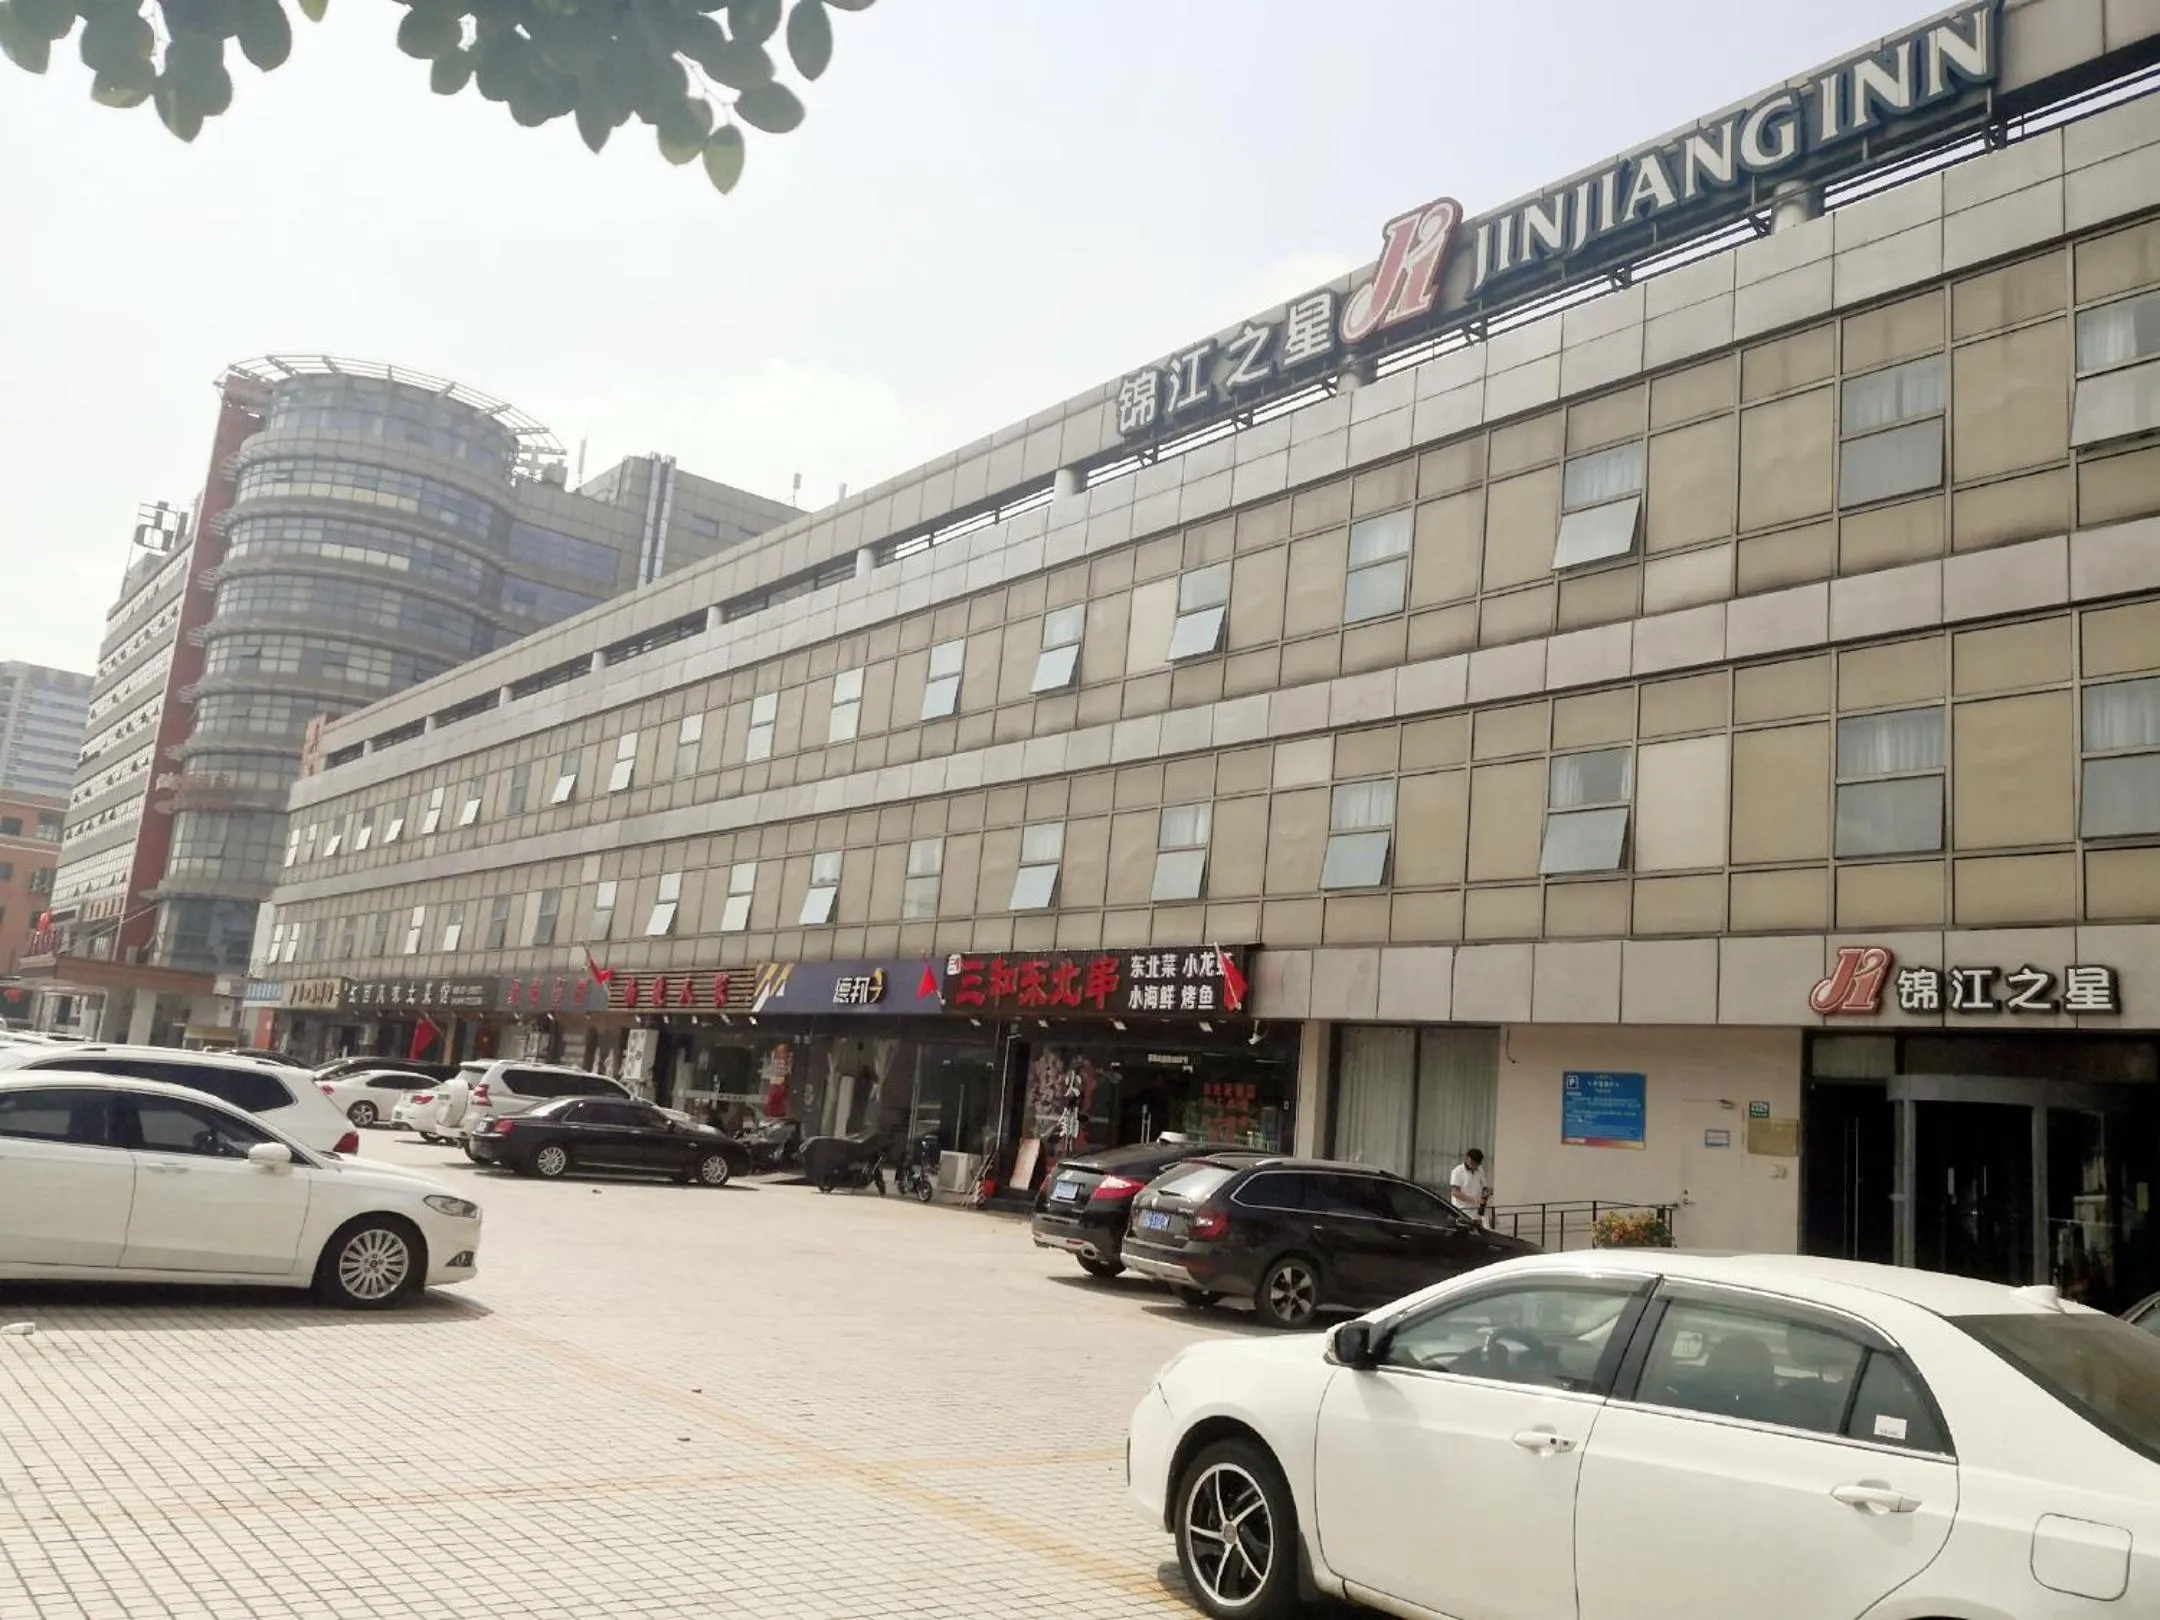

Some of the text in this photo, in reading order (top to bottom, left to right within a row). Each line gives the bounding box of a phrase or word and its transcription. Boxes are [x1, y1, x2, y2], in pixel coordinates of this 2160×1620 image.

[1473, 9, 1990, 291] JINJIANG INN
[1119, 292, 1334, 427] 锦江之星
[1130, 953, 1177, 978] 东北菜
[1898, 965, 2114, 1010] 锦江之星
[1128, 984, 1215, 1010] 小海鲜 烤鱼
